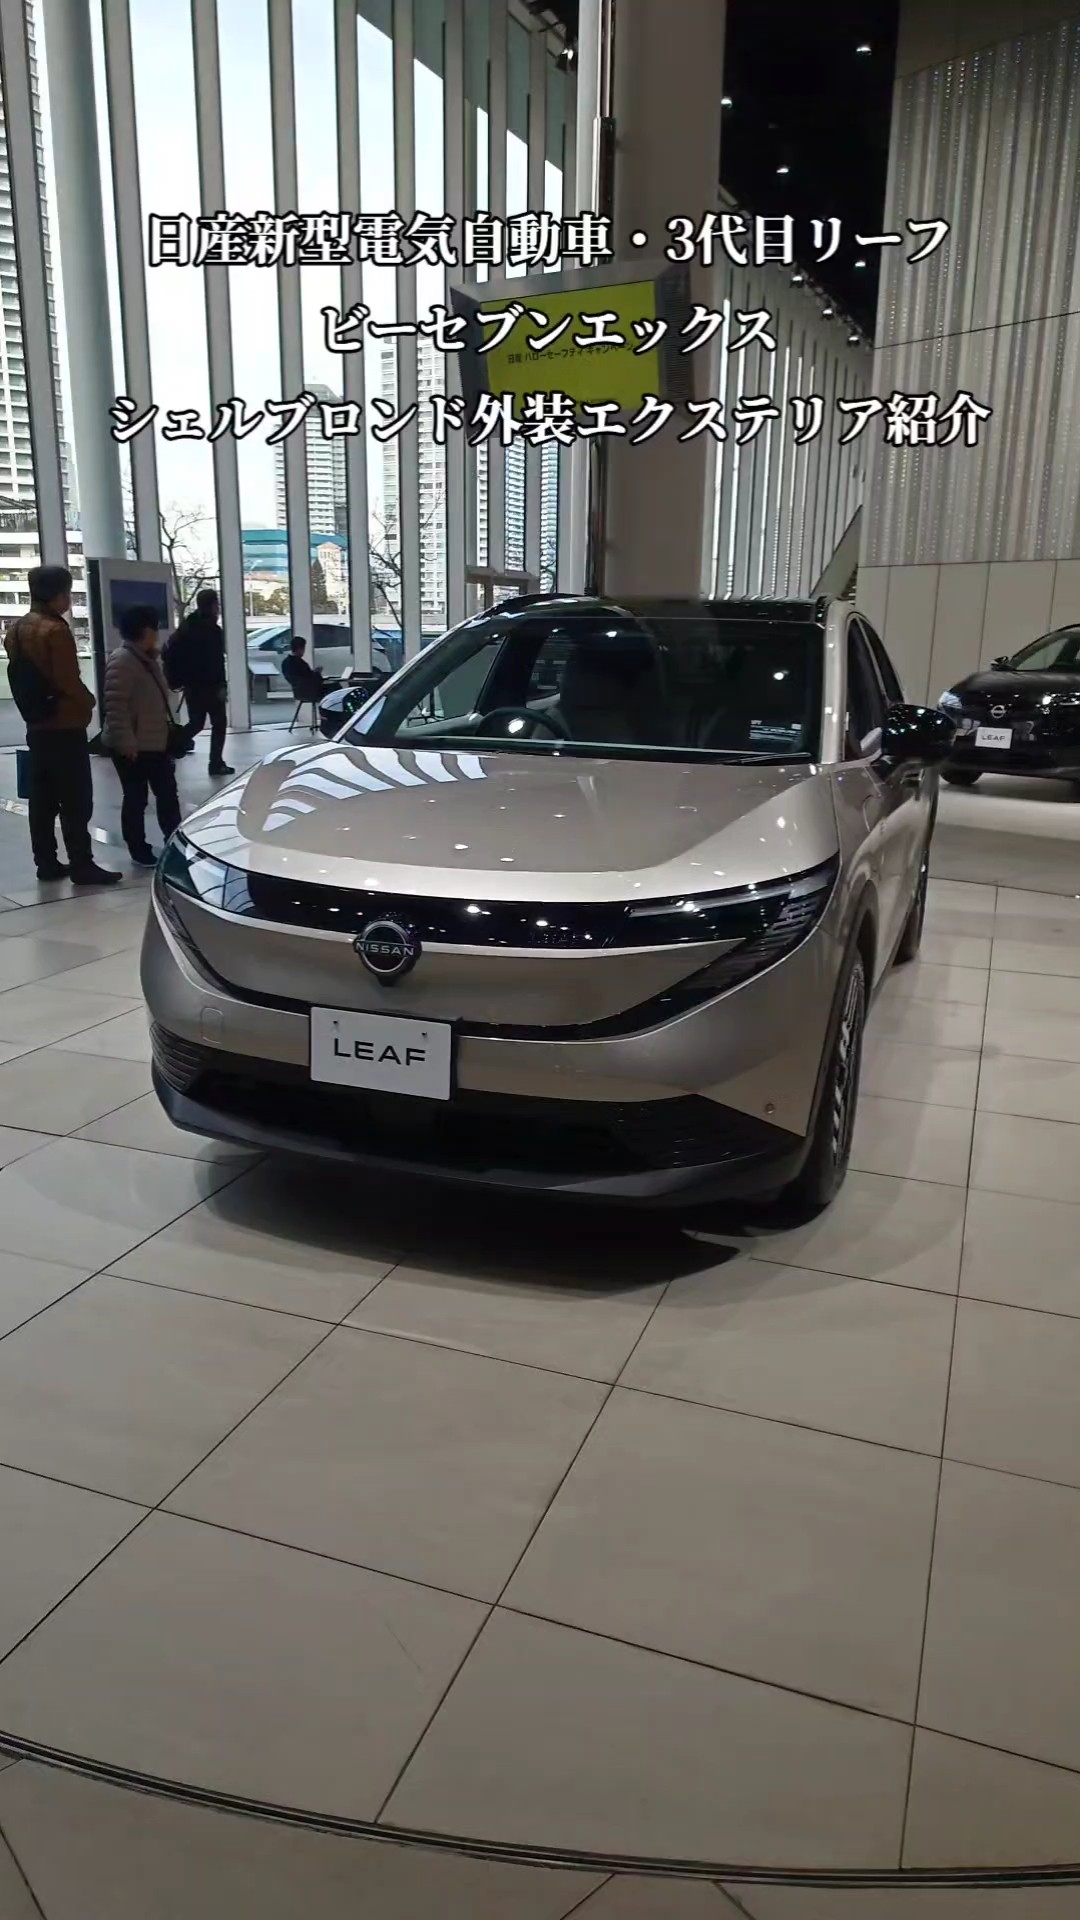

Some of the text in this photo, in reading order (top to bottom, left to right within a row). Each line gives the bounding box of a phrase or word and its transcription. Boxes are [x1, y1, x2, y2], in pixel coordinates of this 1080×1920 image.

[981, 734, 1005, 742] LEAF
[355, 941, 415, 956] NISSAN
[334, 1038, 426, 1066] LEAF
